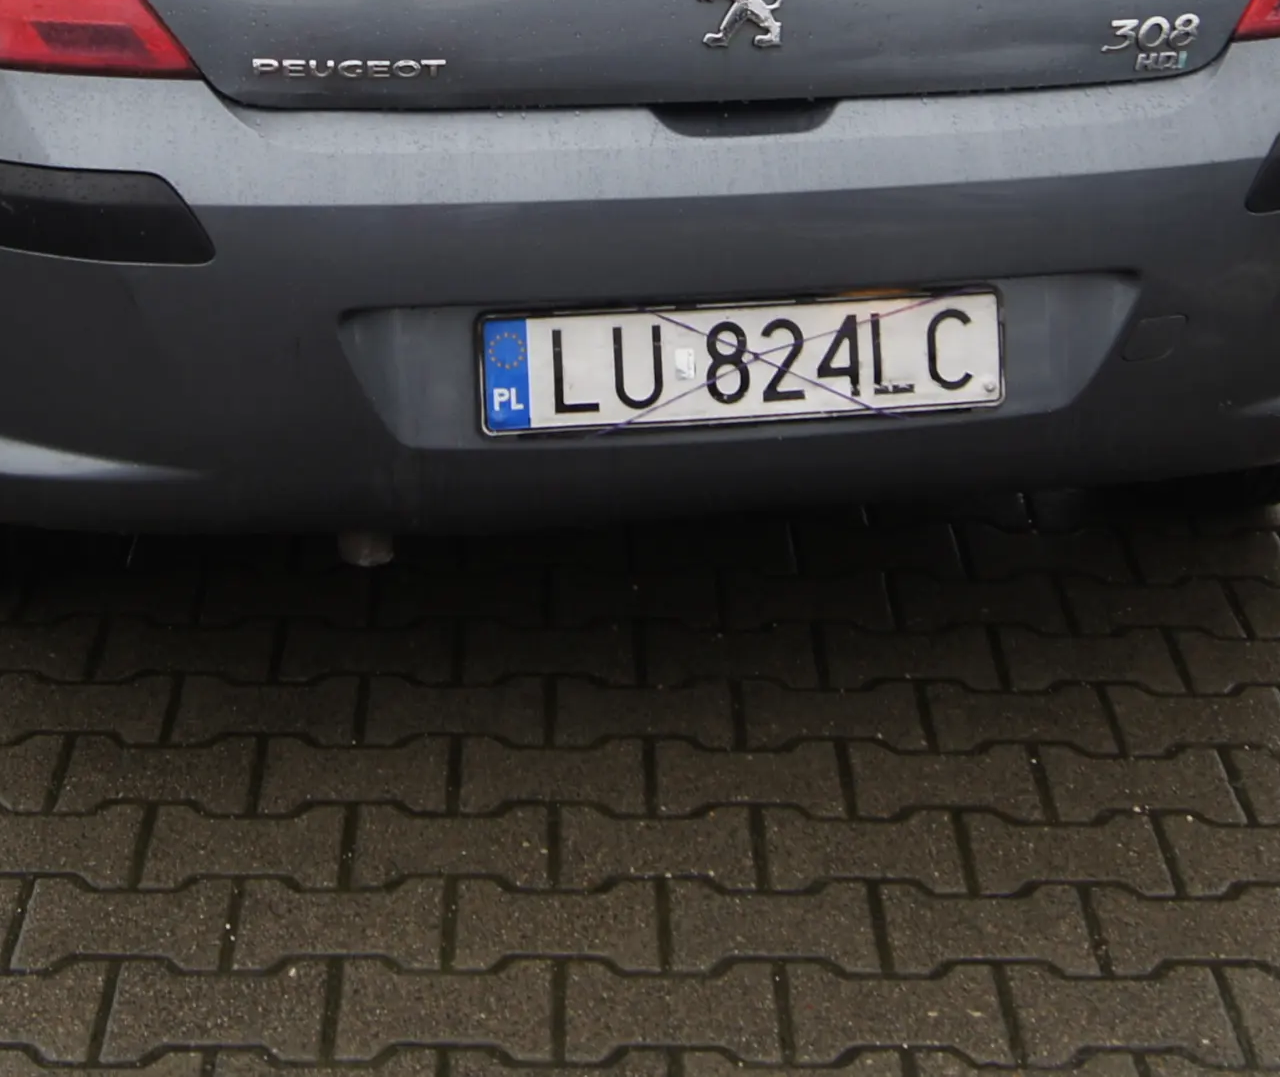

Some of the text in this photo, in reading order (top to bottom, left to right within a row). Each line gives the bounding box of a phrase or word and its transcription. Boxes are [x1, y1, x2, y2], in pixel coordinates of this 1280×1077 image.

[1101, 13, 1201, 52] 308
[251, 58, 447, 78] PEUGEOT
[551, 307, 974, 414] LU 824LC
[492, 387, 524, 412] PL
